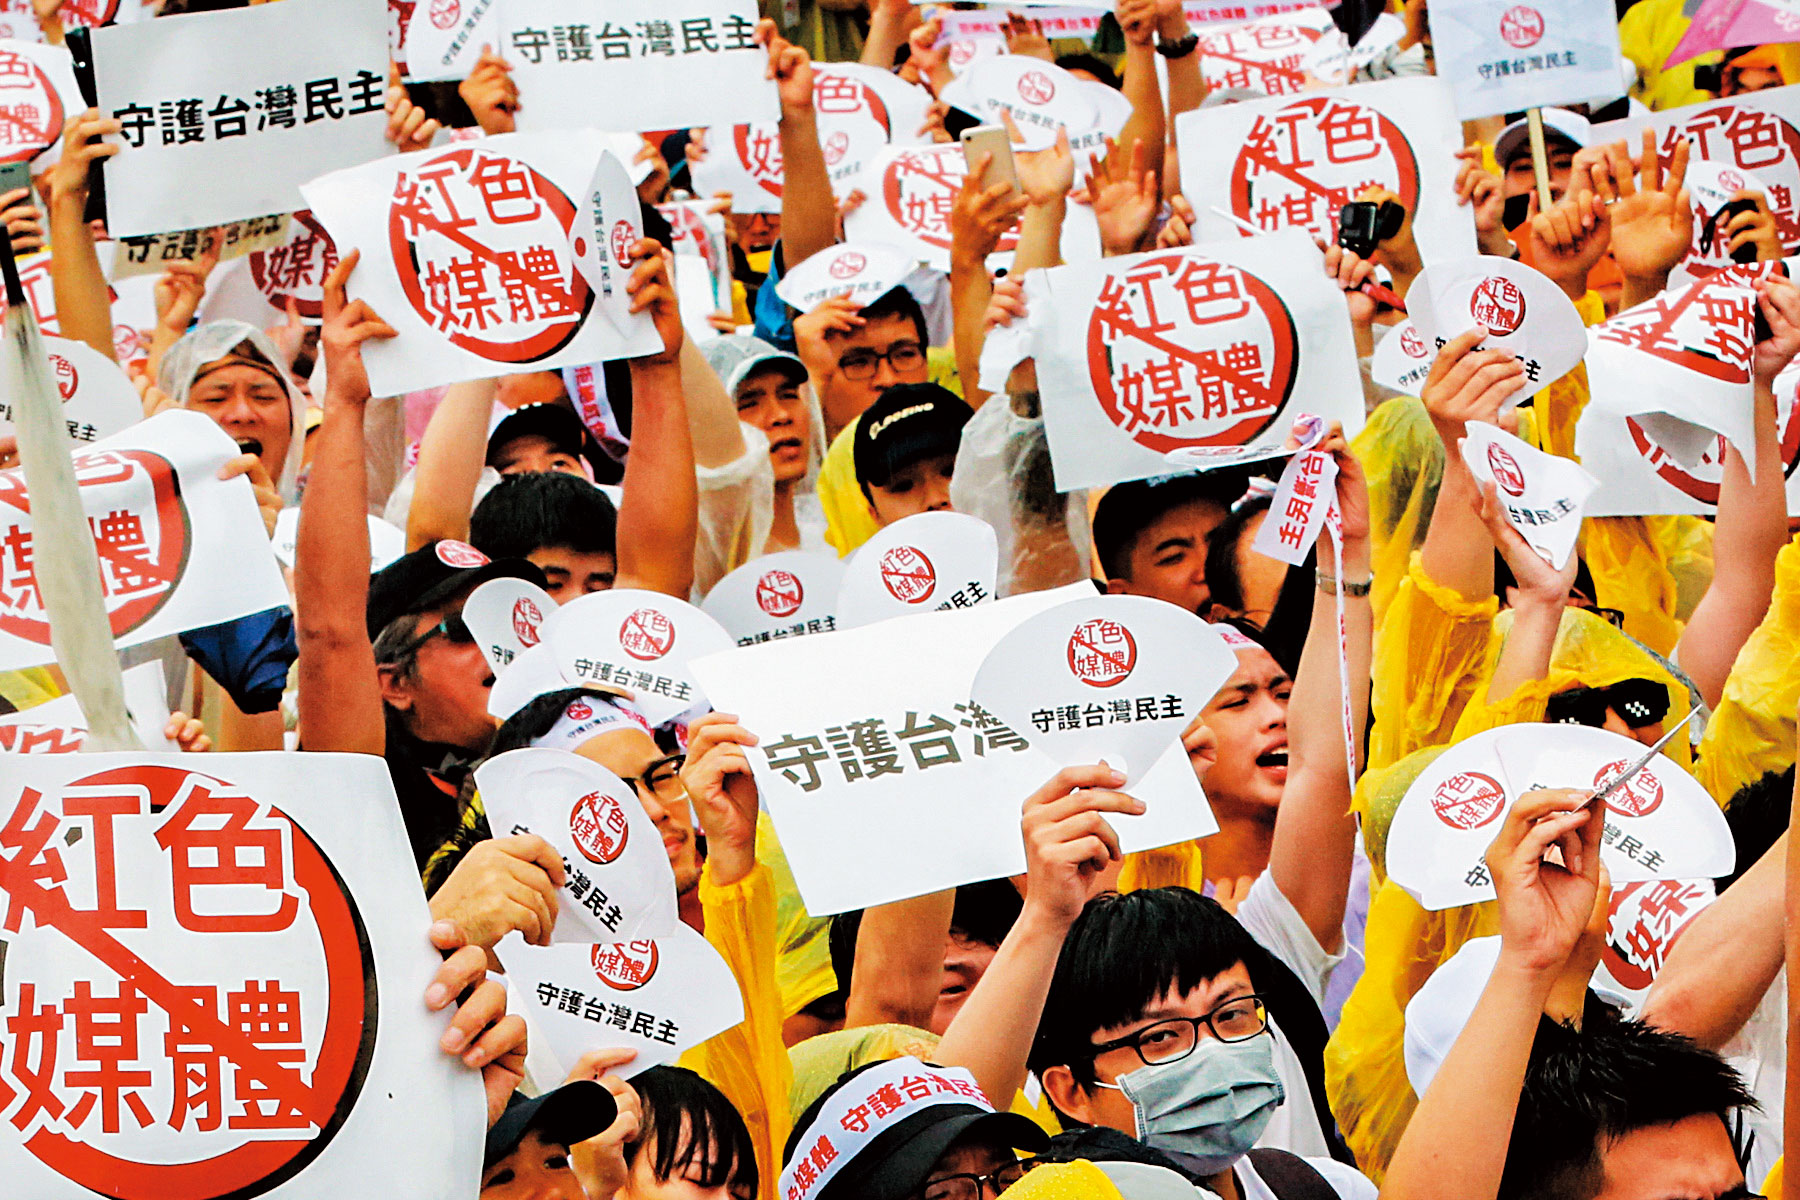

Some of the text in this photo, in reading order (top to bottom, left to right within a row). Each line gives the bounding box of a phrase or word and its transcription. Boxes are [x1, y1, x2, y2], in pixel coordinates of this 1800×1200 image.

[512, 15, 760, 64] 守護台灣民主
[1477, 50, 1578, 80] 守護台灣民主
[114, 69, 386, 149] 守護台灣民主
[1248, 106, 1382, 176] 紅色
[394, 149, 542, 236] 紅色
[425, 245, 581, 334] 媒體
[1098, 256, 1250, 342] 紅色
[1118, 339, 1271, 430] 媒體
[622, 630, 672, 657] 媒體
[623, 608, 672, 633] 紅色
[1072, 620, 1125, 651] 紅色
[573, 656, 692, 702] 守護台灣民主
[1073, 650, 1137, 681] 媒體
[1030, 694, 1186, 734] 守護台灣民主
[579, 790, 628, 834] 紅色
[1430, 771, 1475, 814] 紅色
[1452, 783, 1504, 831] 媒體
[571, 812, 624, 862] 媒體
[594, 947, 649, 984] 媒體
[536, 979, 680, 1047] 守護台灣民主
[6, 978, 314, 1134] 媒體
